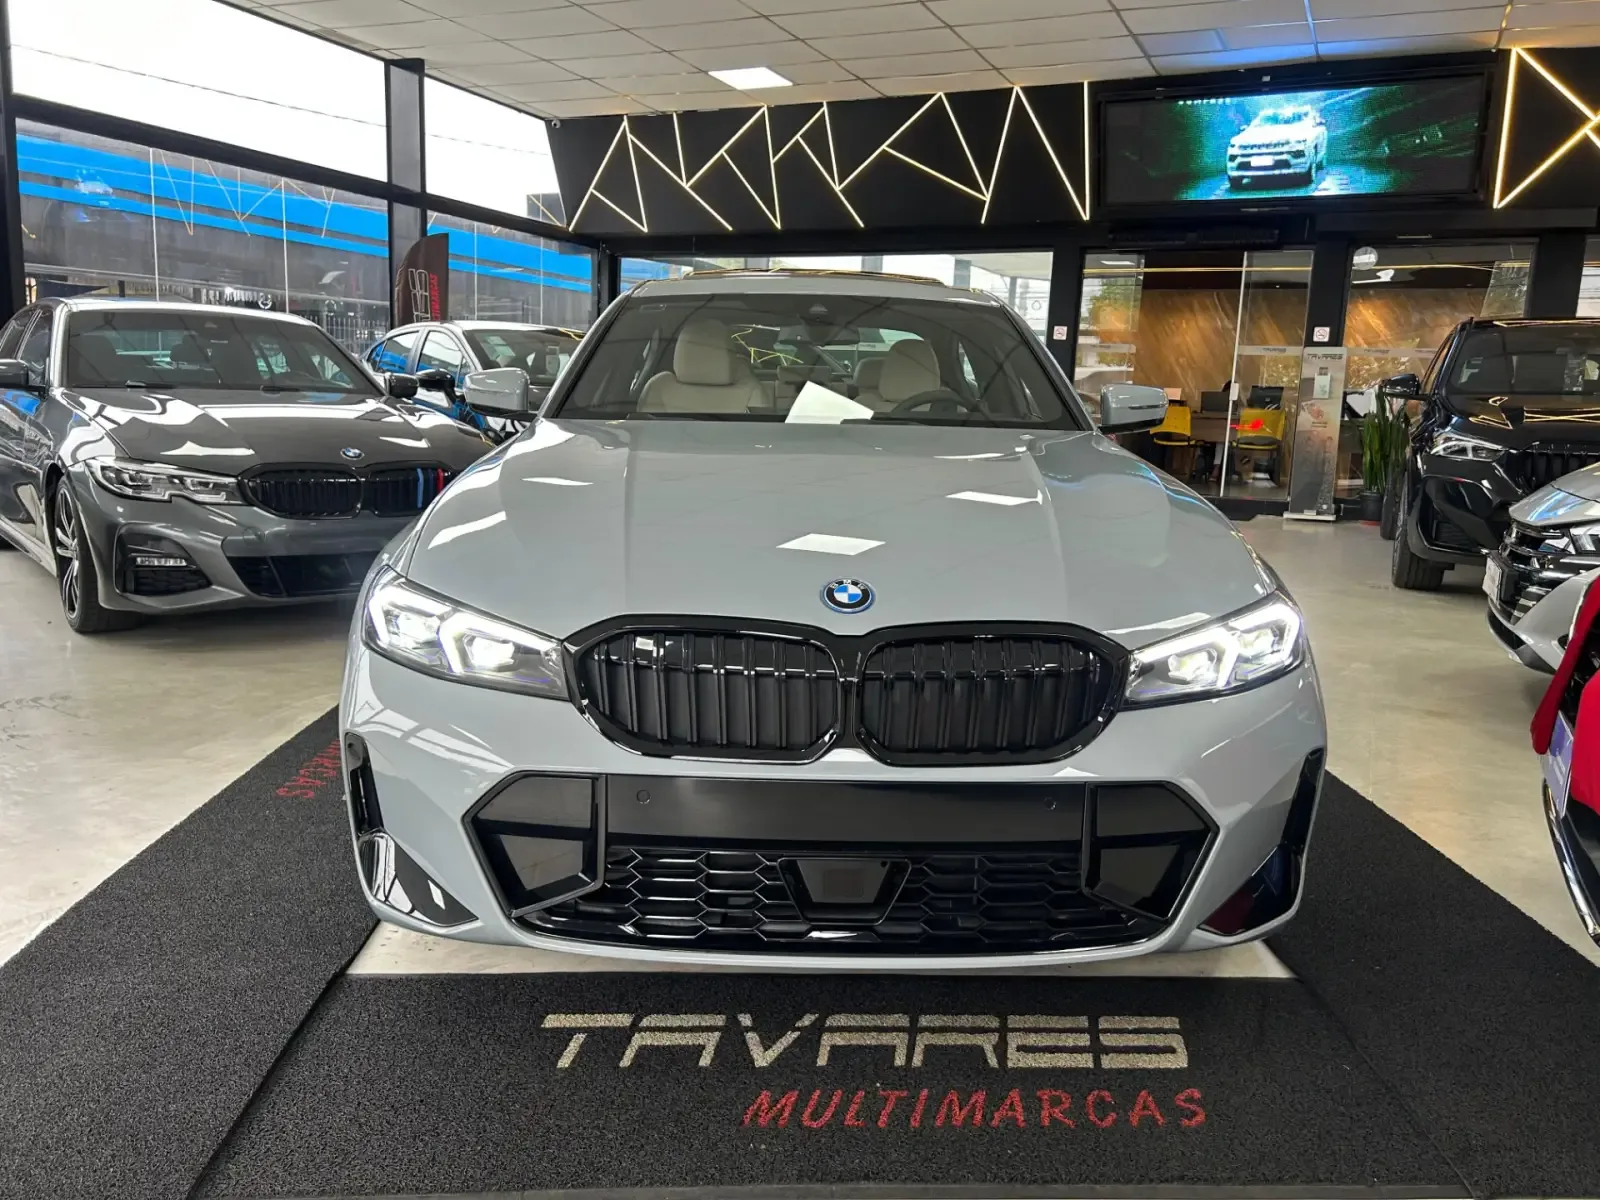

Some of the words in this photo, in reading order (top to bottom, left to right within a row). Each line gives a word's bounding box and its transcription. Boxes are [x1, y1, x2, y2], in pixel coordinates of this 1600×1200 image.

[1307, 353, 1344, 361] TAVARES
[541, 1013, 1189, 1069] TAVARES
[741, 1088, 1206, 1129] MULTIMARCAS
